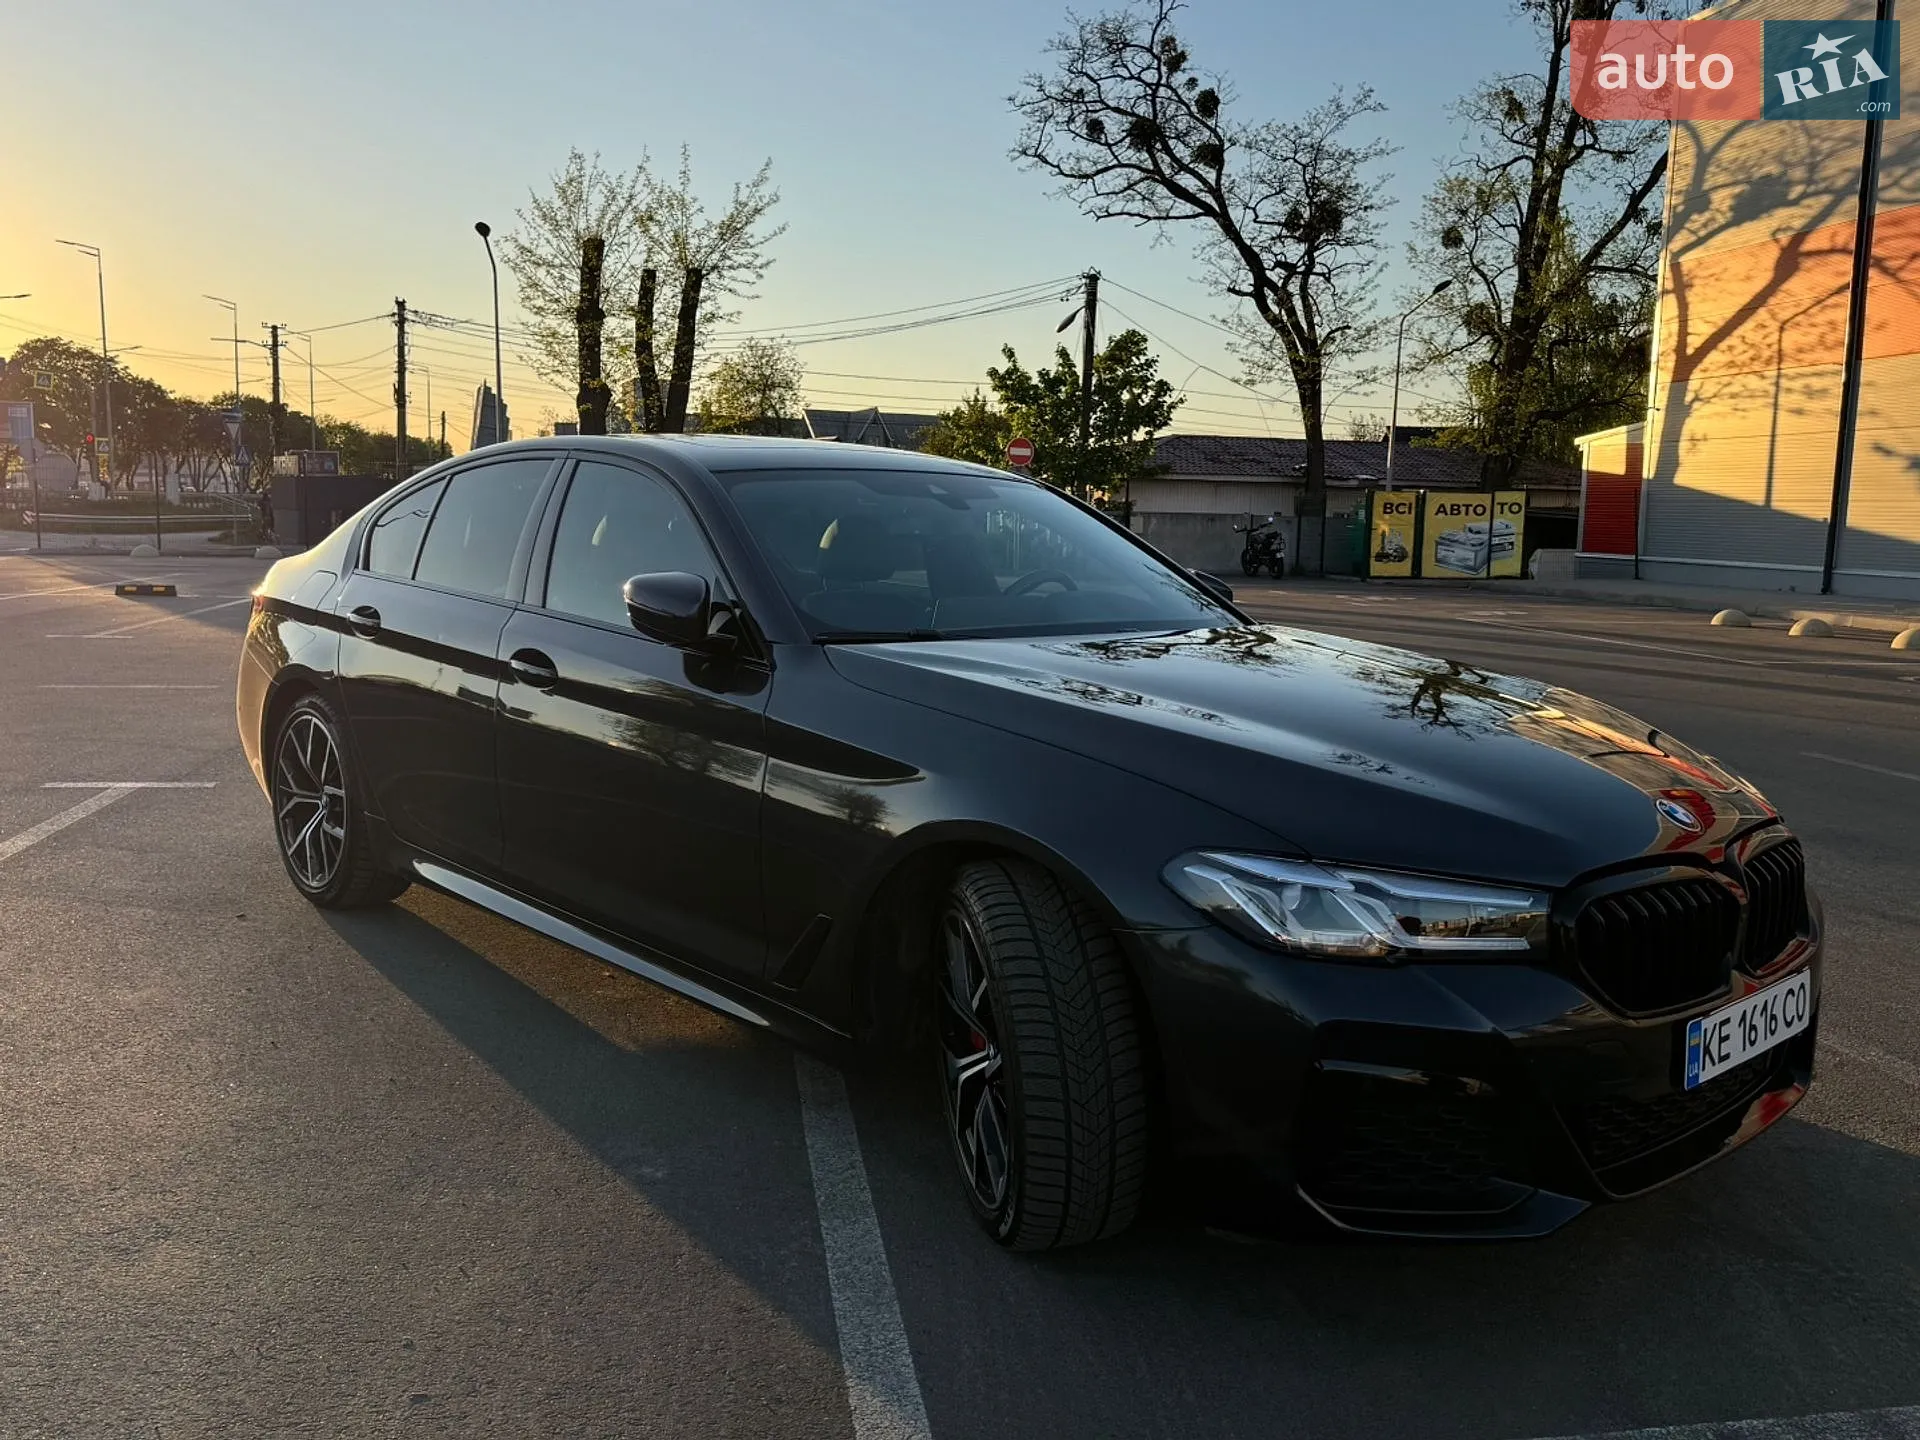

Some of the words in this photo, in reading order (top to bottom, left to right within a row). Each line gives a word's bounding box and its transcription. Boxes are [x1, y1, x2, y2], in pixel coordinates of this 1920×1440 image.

[1383, 502, 1412, 515] ВСІ
[1435, 503, 1487, 516] АВТО
[1497, 502, 1522, 515] ТО
[1702, 1017, 1731, 1072] KE
[1738, 994, 1778, 1052] 1616
[1783, 982, 1807, 1028] CO
[1689, 1061, 1699, 1077] UA
